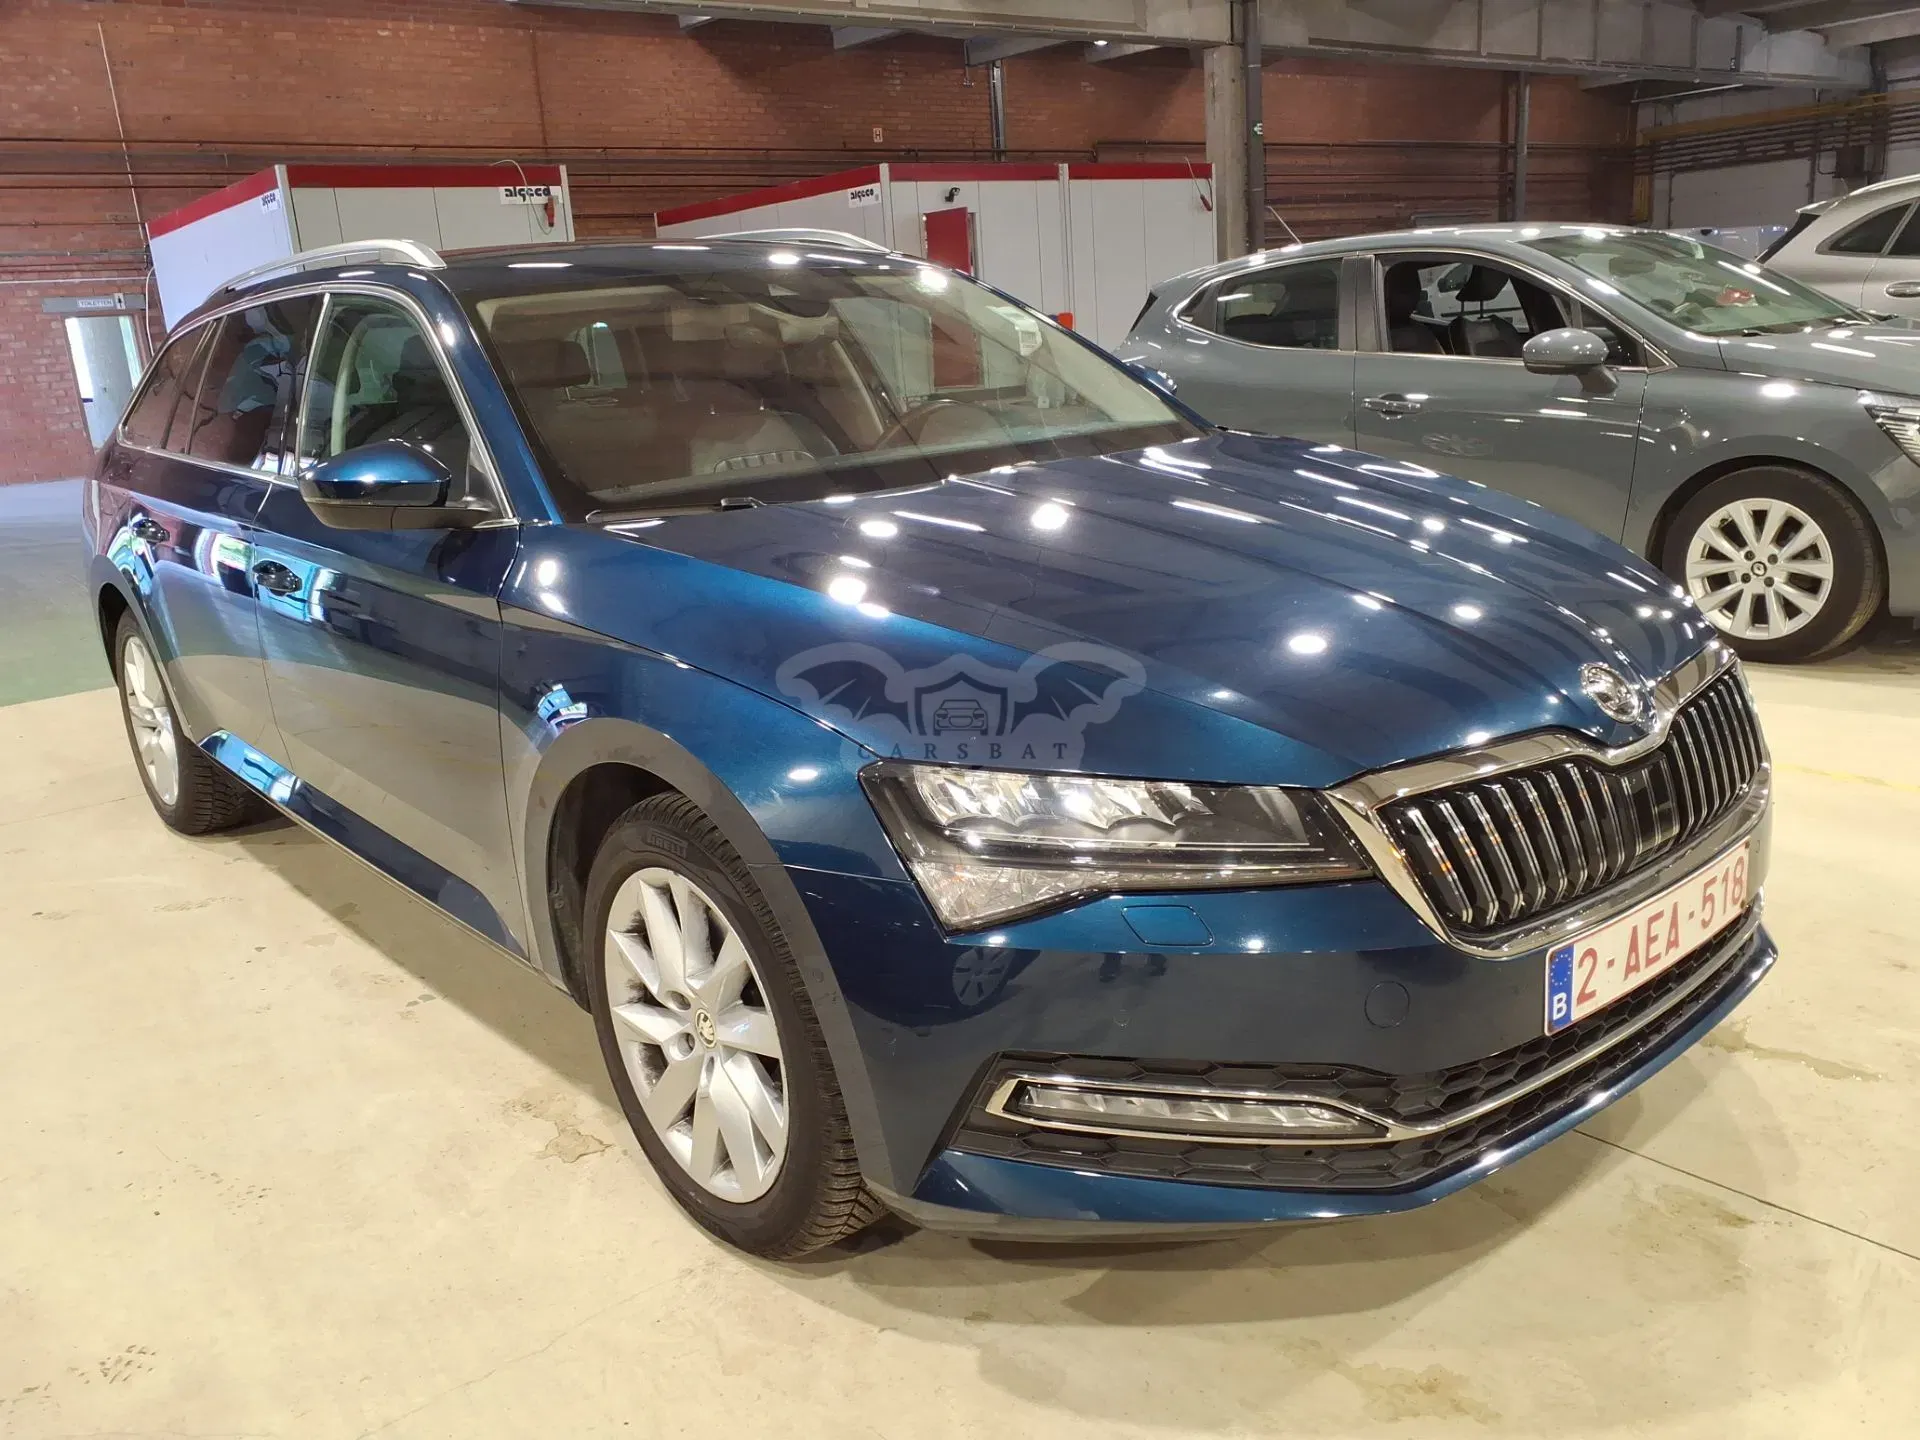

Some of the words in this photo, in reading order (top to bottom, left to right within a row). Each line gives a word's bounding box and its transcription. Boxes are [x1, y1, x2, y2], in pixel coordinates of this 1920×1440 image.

[504, 186, 551, 202] algeco
[850, 189, 874, 202] algeco
[1576, 856, 1745, 1007] 2-AEA-518
[1552, 992, 1568, 1021] B
